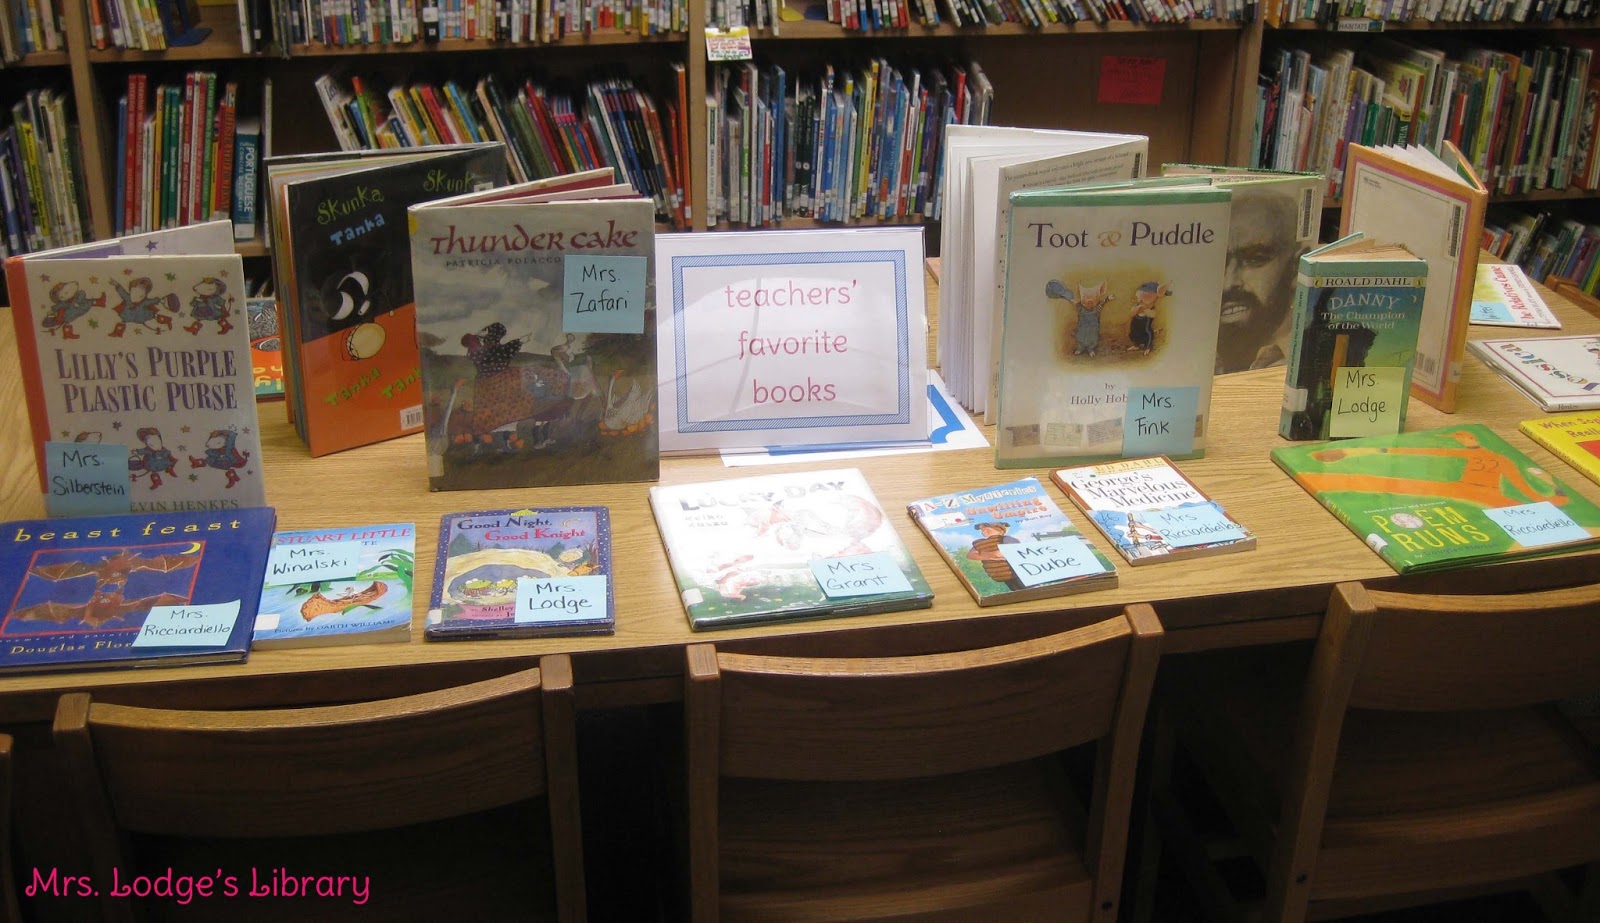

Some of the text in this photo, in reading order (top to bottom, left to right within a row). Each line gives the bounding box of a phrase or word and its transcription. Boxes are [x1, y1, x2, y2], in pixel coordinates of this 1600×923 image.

[244, 147, 255, 212] PORTUGUESE
[423, 169, 474, 193] Skunk
[317, 185, 385, 225] Skunka
[330, 213, 385, 246] Tanka
[571, 219, 638, 251] cake
[1027, 222, 1089, 249] Toot
[1129, 221, 1215, 247] Puddle
[446, 256, 562, 267] PATRICIA POLACCO
[582, 264, 621, 283] Mrs.
[1325, 277, 1411, 287] ROALD DAHL
[570, 289, 629, 314] Zafari
[1330, 293, 1401, 310] DANNY
[1321, 311, 1407, 321] The Champion
[1328, 321, 1395, 331] of the World
[738, 329, 848, 360] favorite
[146, 346, 237, 378] PURPLE
[324, 367, 381, 407] Tanka
[381, 367, 422, 399] Tank
[753, 376, 837, 405] books
[1105, 382, 1116, 391] by
[62, 382, 238, 414] PLASTIC PURSE
[1070, 393, 1128, 405] Holly Hob
[1141, 392, 1175, 409] Mrs.
[1337, 396, 1386, 422] Lodge
[1134, 418, 1170, 437] Fink
[1537, 415, 1600, 429] When Sop
[1565, 427, 1600, 438] Reall
[62, 450, 104, 469] Mrs.
[1470, 456, 1499, 474] 32
[52, 476, 125, 496] Silberstein
[783, 481, 845, 498] DAY
[1086, 480, 1188, 500] Marvelous
[130, 499, 239, 513] EVIN HENKES
[1109, 489, 1199, 509] Medicine
[14, 519, 241, 543] beast feast
[457, 519, 500, 531] Good
[484, 528, 586, 541] Good Knight
[277, 528, 412, 545] STUART LITTLE
[1391, 524, 1490, 552] RUNS
[290, 548, 331, 559] Mrs.
[273, 558, 348, 575] Winalski
[1019, 554, 1081, 577] Dube
[826, 575, 888, 591] Grant
[529, 595, 592, 614] Lodge
[170, 609, 208, 620] Mrs.
[144, 624, 232, 637] Ricciardiello
[10, 640, 133, 655] Douglas Flor
